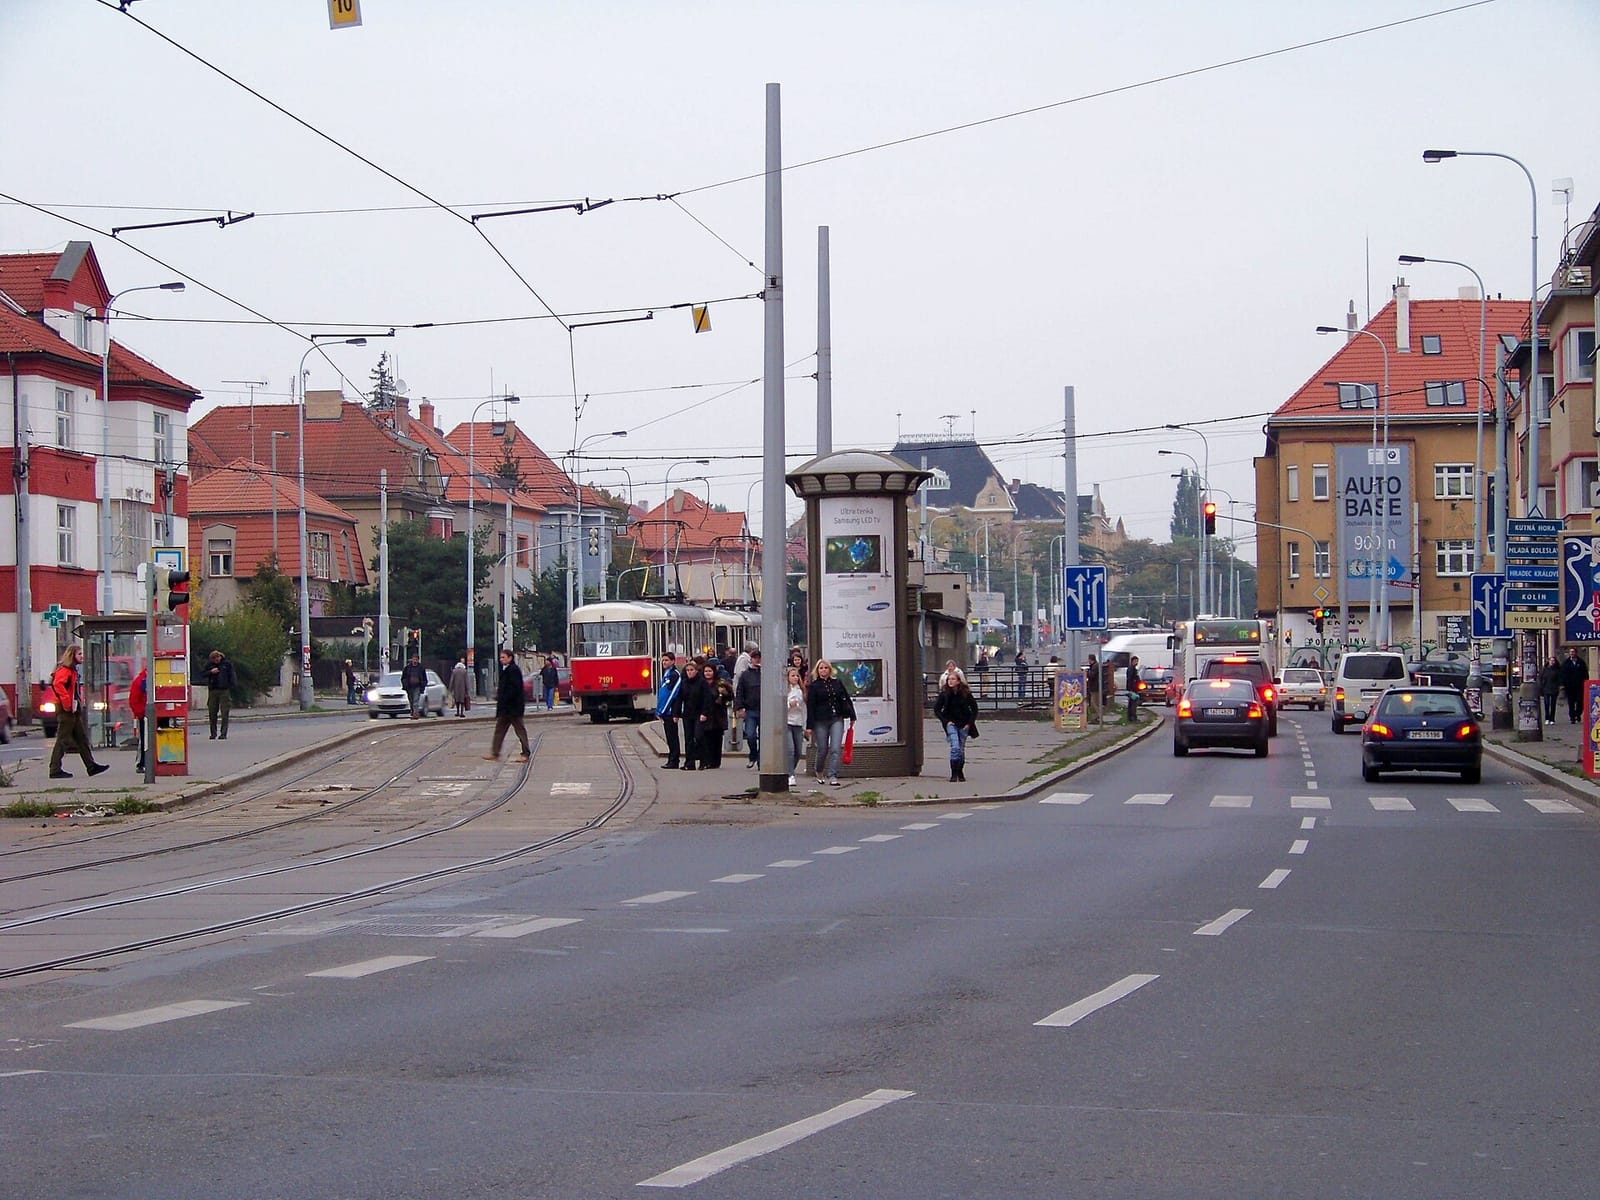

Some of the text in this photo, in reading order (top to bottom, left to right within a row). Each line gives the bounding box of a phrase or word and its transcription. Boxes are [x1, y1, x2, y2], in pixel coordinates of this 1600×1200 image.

[1345, 476, 1402, 495] AUTO
[1345, 498, 1402, 516] BASE
[834, 517, 860, 525] Samsung
[1538, 524, 1556, 532] HORA
[863, 640, 875, 648] LED
[599, 644, 609, 654] 22
